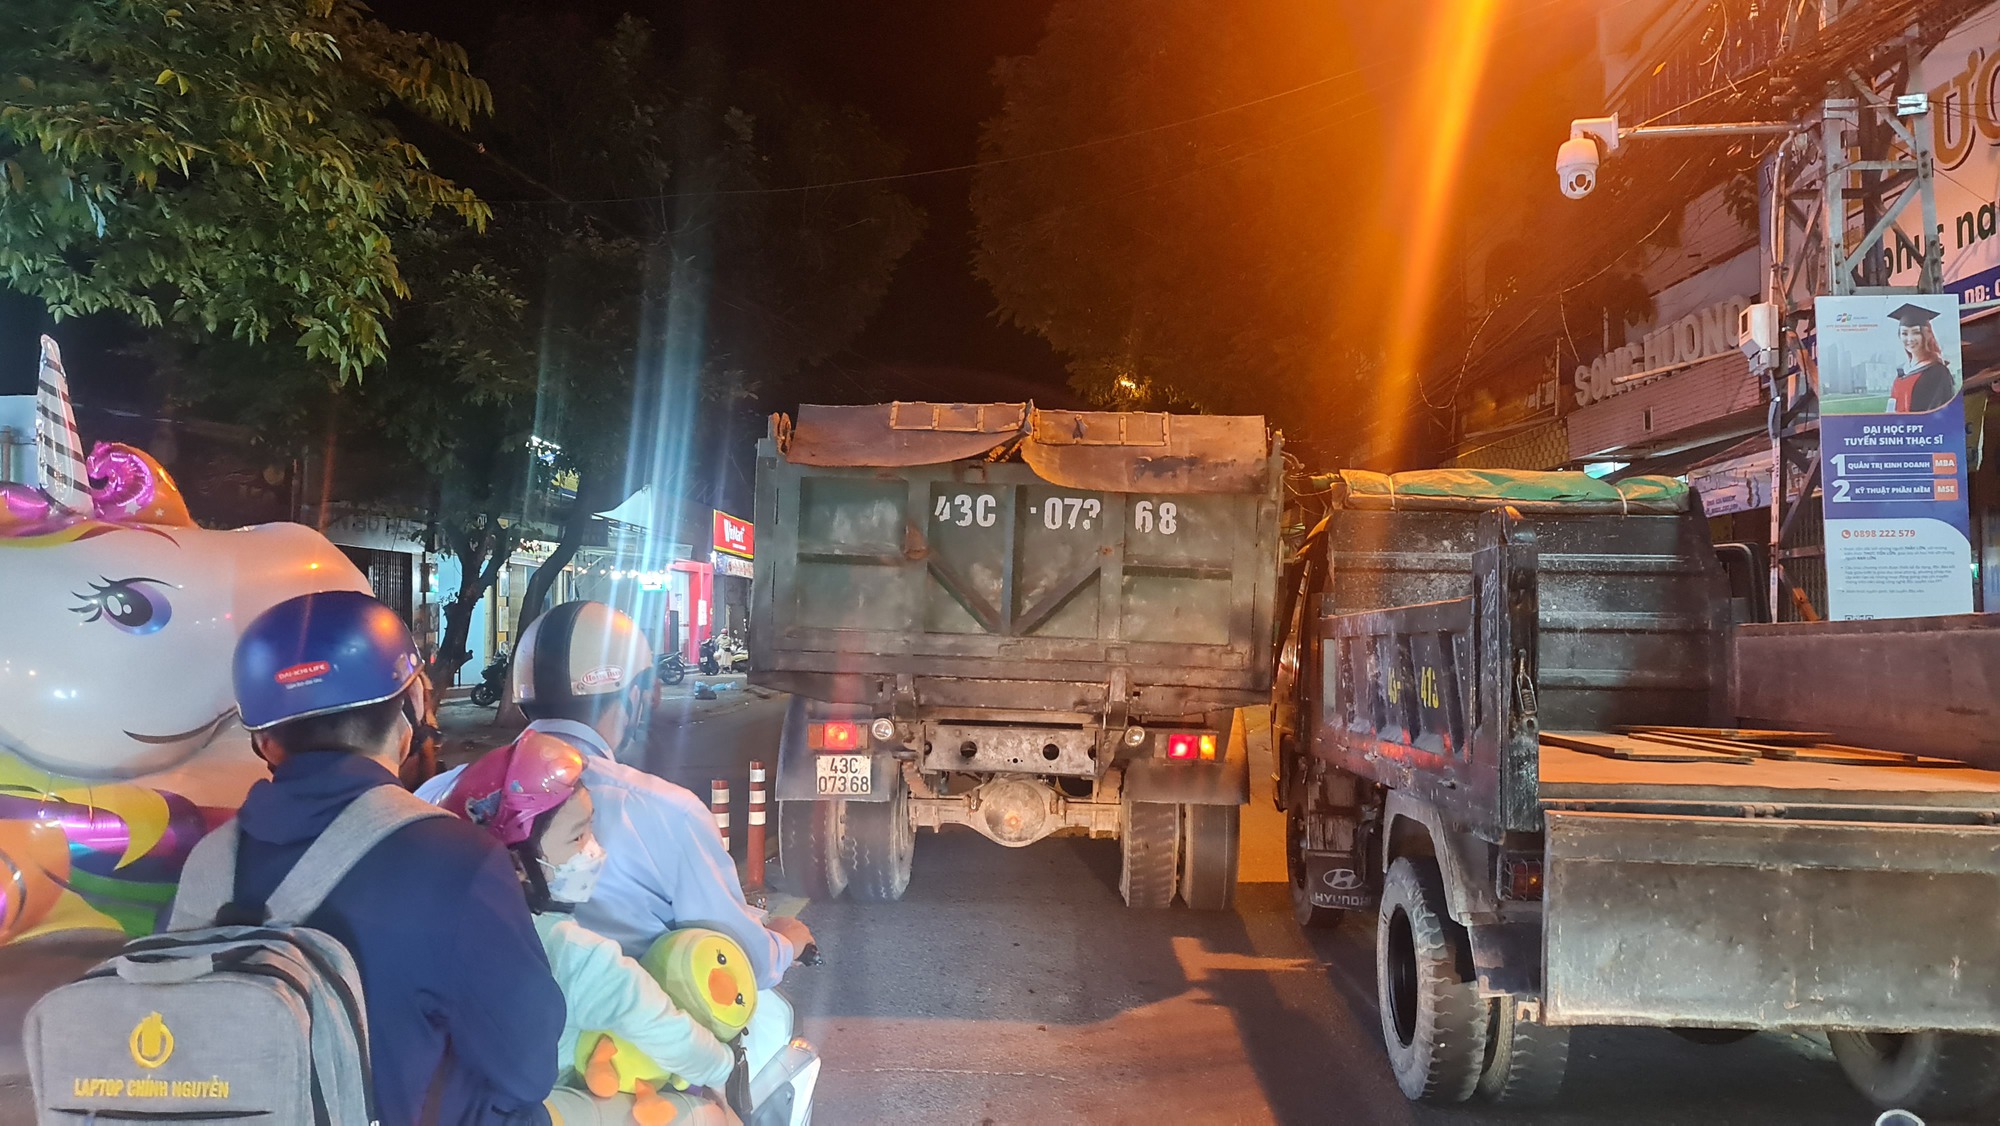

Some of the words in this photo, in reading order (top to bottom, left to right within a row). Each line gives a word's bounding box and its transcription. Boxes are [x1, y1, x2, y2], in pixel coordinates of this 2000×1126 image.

[1863, 425, 1880, 436] ĐẠI
[1883, 425, 1904, 435] HỌC
[1907, 425, 1923, 434] FPT
[1879, 437, 1903, 445] SINH
[1906, 436, 1931, 447] THẠC
[1830, 454, 1846, 476] 1
[1884, 461, 1902, 469] KINH
[1904, 461, 1930, 469] DOANH
[1935, 459, 1955, 467] MBA
[1831, 479, 1851, 503] 2
[1937, 485, 1955, 493] MSE
[934, 494, 996, 527] 43C
[1135, 500, 1177, 535] 68
[1853, 529, 1877, 538] 0898
[1879, 529, 1896, 538] 222
[1898, 529, 1916, 538] 579
[829, 757, 858, 774] 43C
[74, 1077, 124, 1098] LAPTOP
